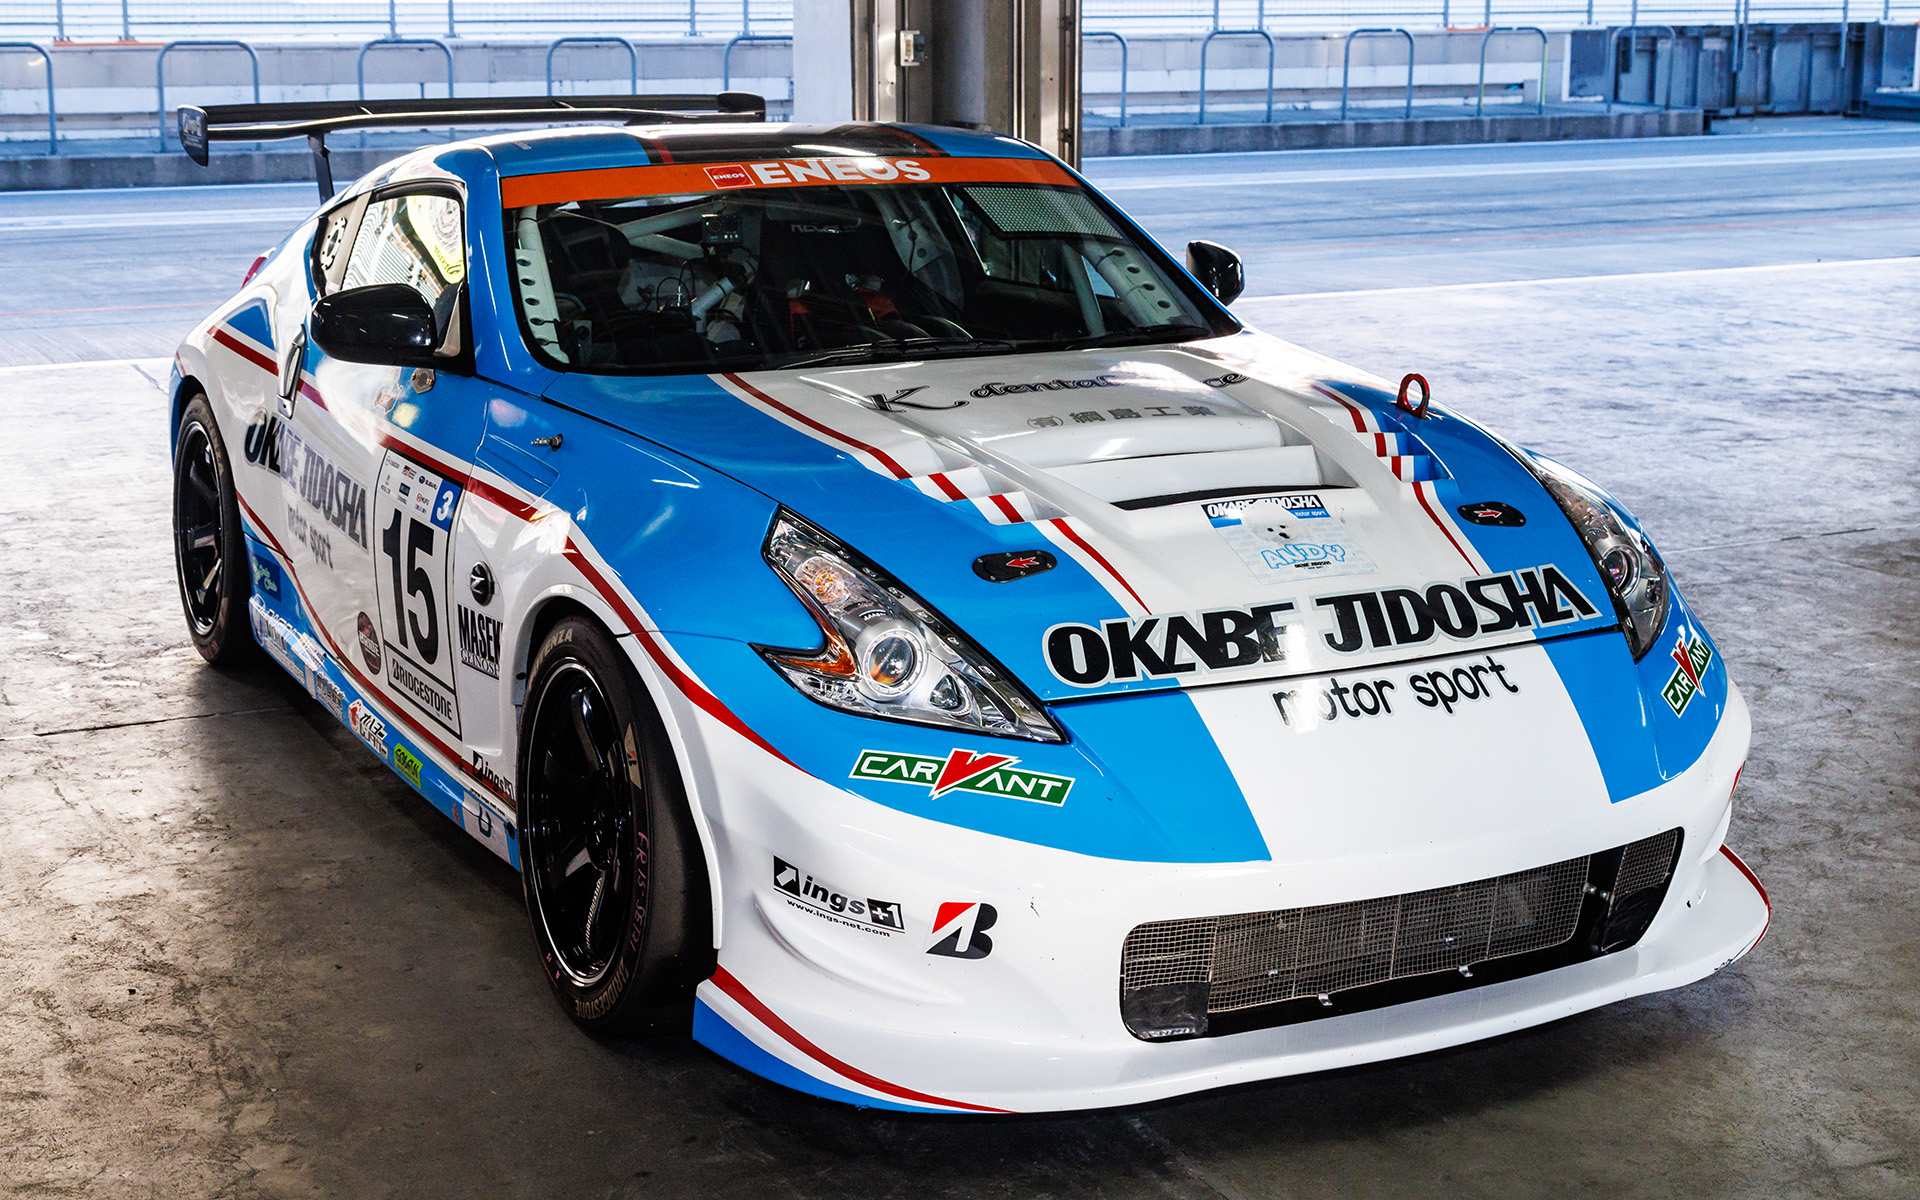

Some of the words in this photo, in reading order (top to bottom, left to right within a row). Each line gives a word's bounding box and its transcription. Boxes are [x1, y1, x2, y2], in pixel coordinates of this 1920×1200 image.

[713, 171, 746, 182] ENEOS
[750, 157, 931, 185] ENEOS
[436, 490, 454, 521] 3
[1261, 543, 1346, 569] ANDY
[383, 508, 439, 666] 15
[457, 603, 504, 662] MASEK
[1048, 601, 1297, 686] OKABE
[1315, 566, 1599, 652] JIDOSHA
[392, 657, 453, 722] BRIDGESTONE
[1271, 675, 1395, 728] motor
[1415, 656, 1520, 715] sport
[859, 748, 1064, 800] CARVANT
[786, 898, 891, 938] www.ings-net.com
